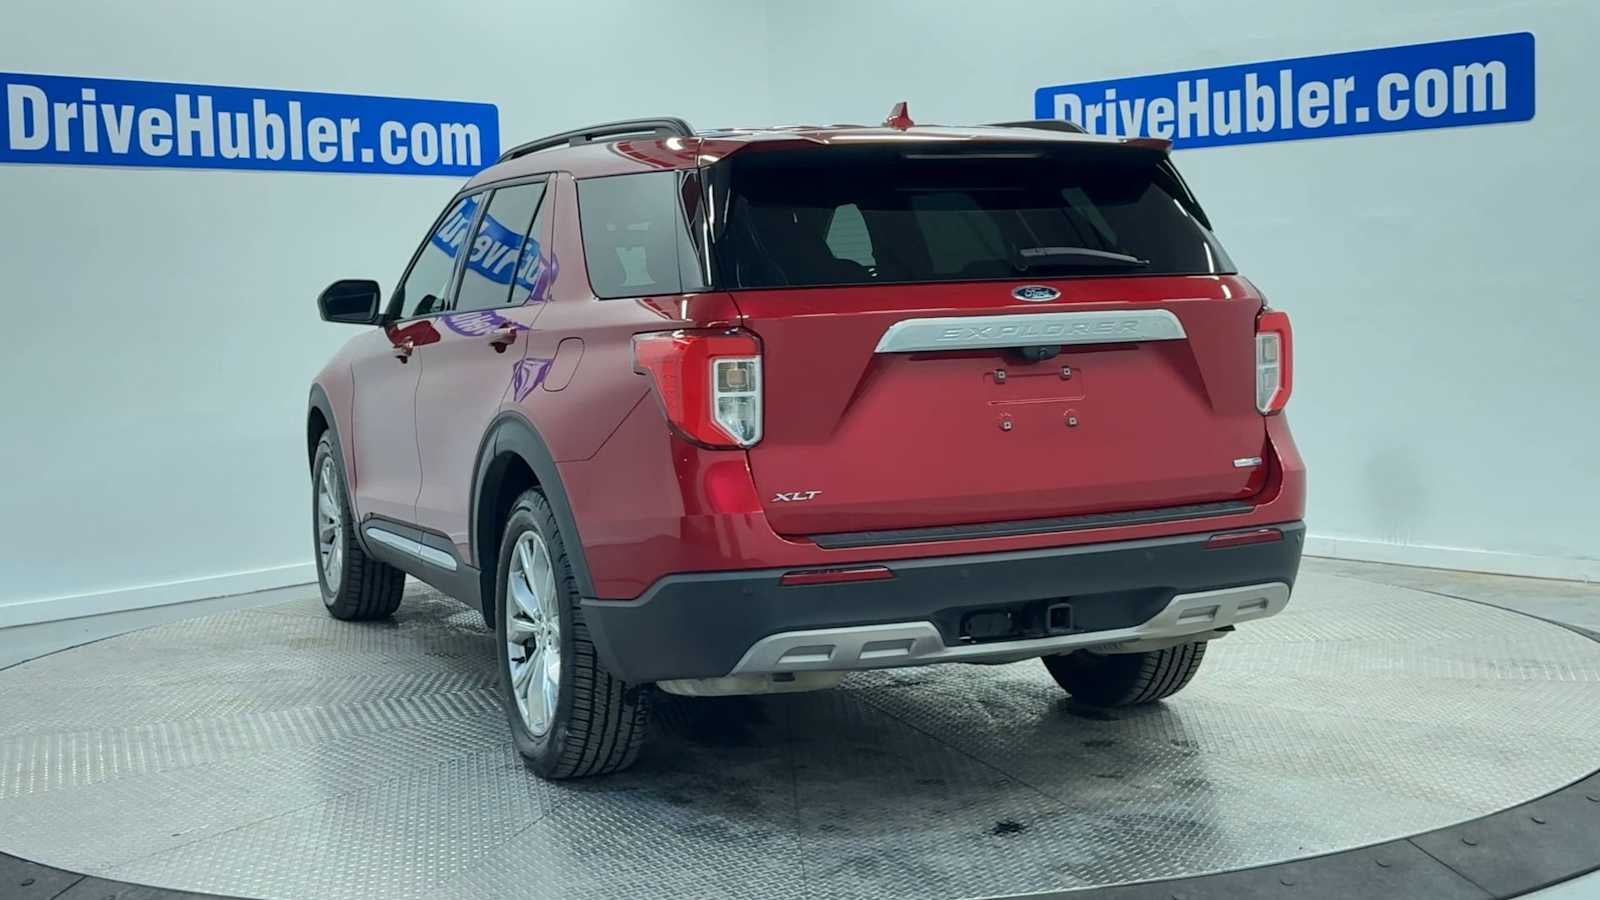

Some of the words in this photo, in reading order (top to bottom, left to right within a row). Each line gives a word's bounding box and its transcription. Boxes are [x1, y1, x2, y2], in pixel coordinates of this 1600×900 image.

[7, 83, 482, 166] DriveHubler.com
[1054, 60, 1507, 139] DriveHubler.com
[936, 320, 1139, 341] EXPLORER
[770, 490, 822, 502] XLT
